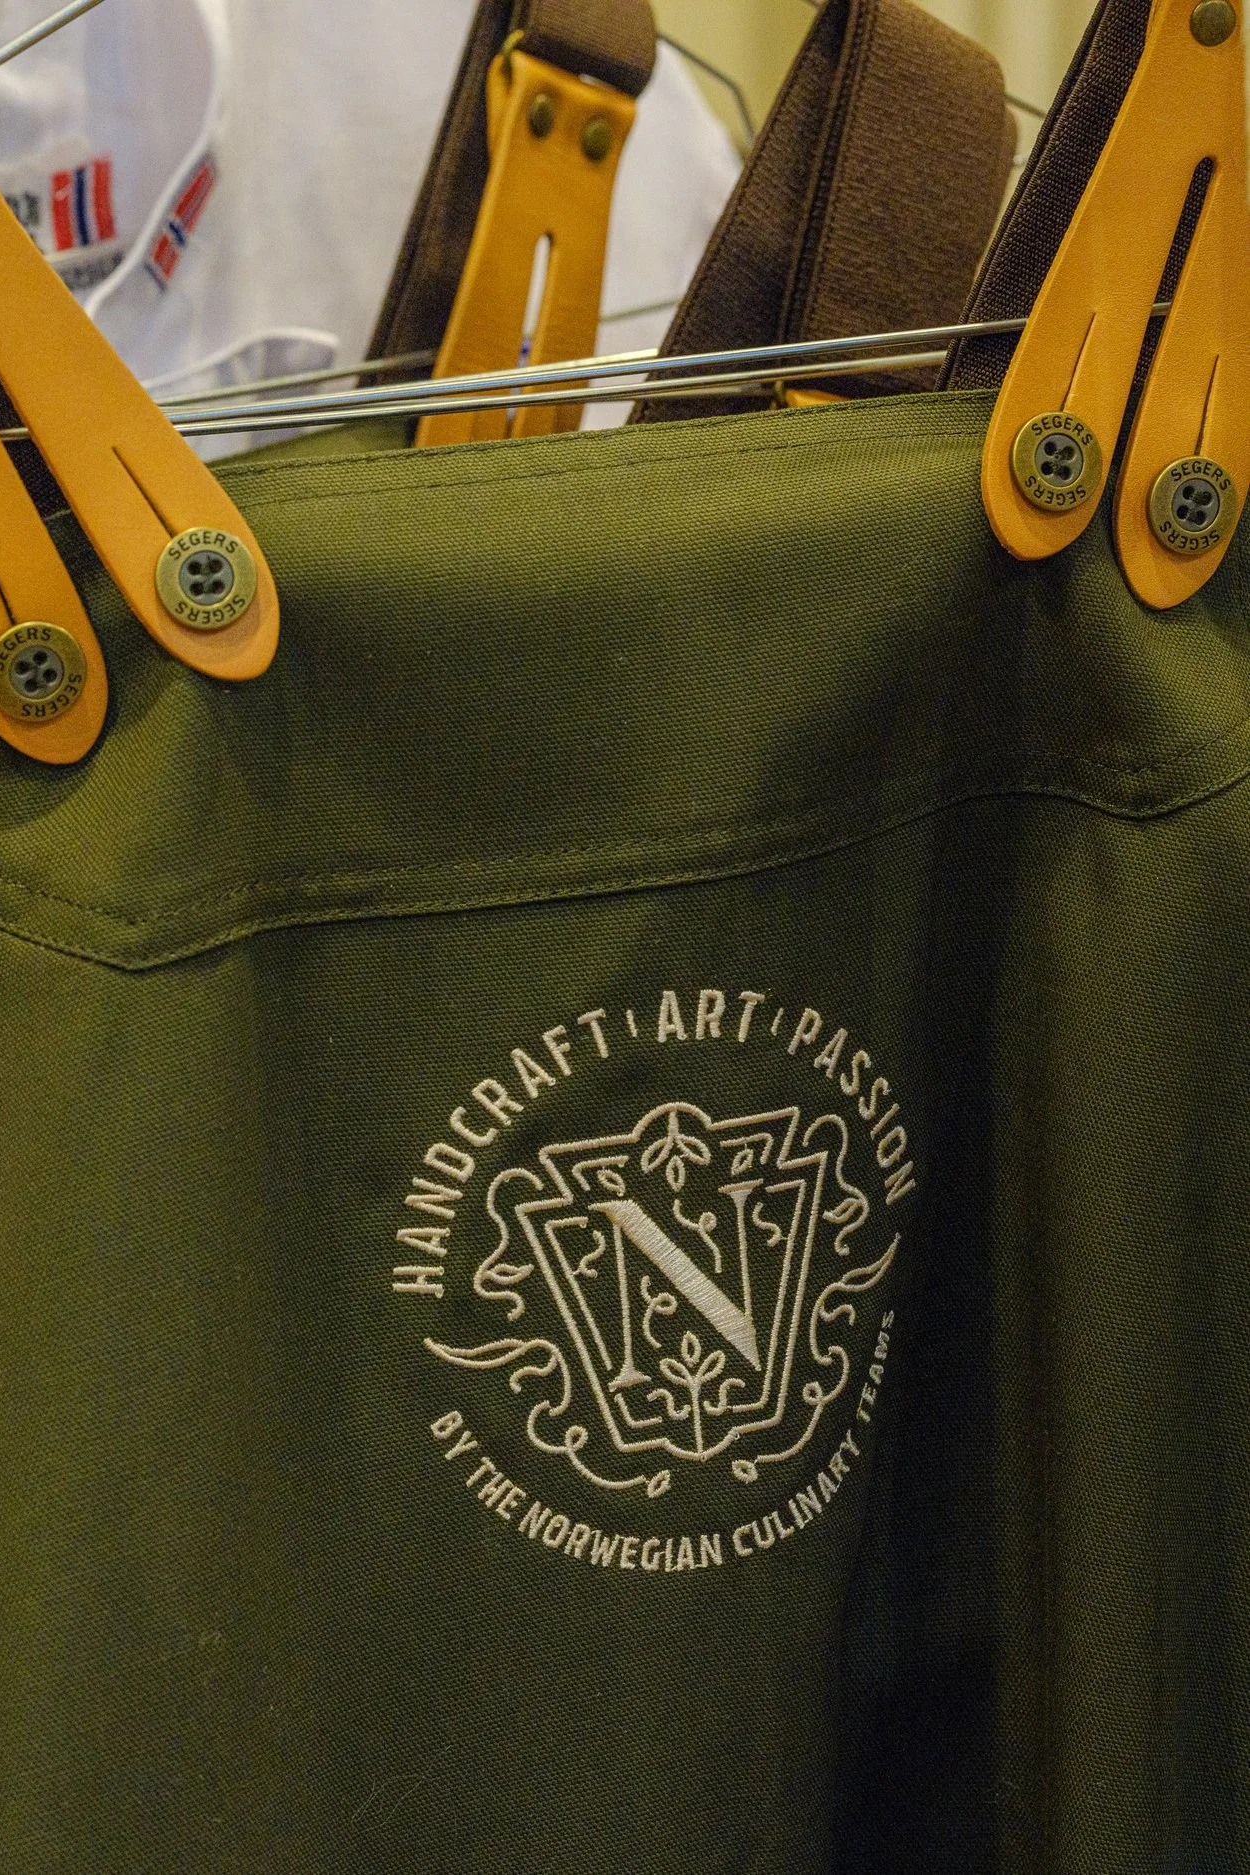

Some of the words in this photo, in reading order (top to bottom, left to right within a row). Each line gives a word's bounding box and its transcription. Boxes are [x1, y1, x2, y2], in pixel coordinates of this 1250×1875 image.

[1031, 415, 1093, 446] SEGERS
[1024, 475, 1086, 506] SEGERS
[1170, 460, 1231, 491] SEGERS
[168, 531, 239, 560] SEGERS
[1159, 521, 1220, 550] SEGERS
[175, 594, 246, 624] SEGERS
[21, 673, 82, 717] SEGERS
[392, 1008, 609, 1299] HANDCRAFT
[657, 988, 765, 1043] ART
[787, 1007, 916, 1206] PASSION
[430, 1409, 479, 1461] BY
[465, 1457, 525, 1520] THE
[517, 1503, 722, 1573] NORWEGIAN
[732, 1430, 859, 1559] CULINARY
[857, 1309, 895, 1422] TEAMS
